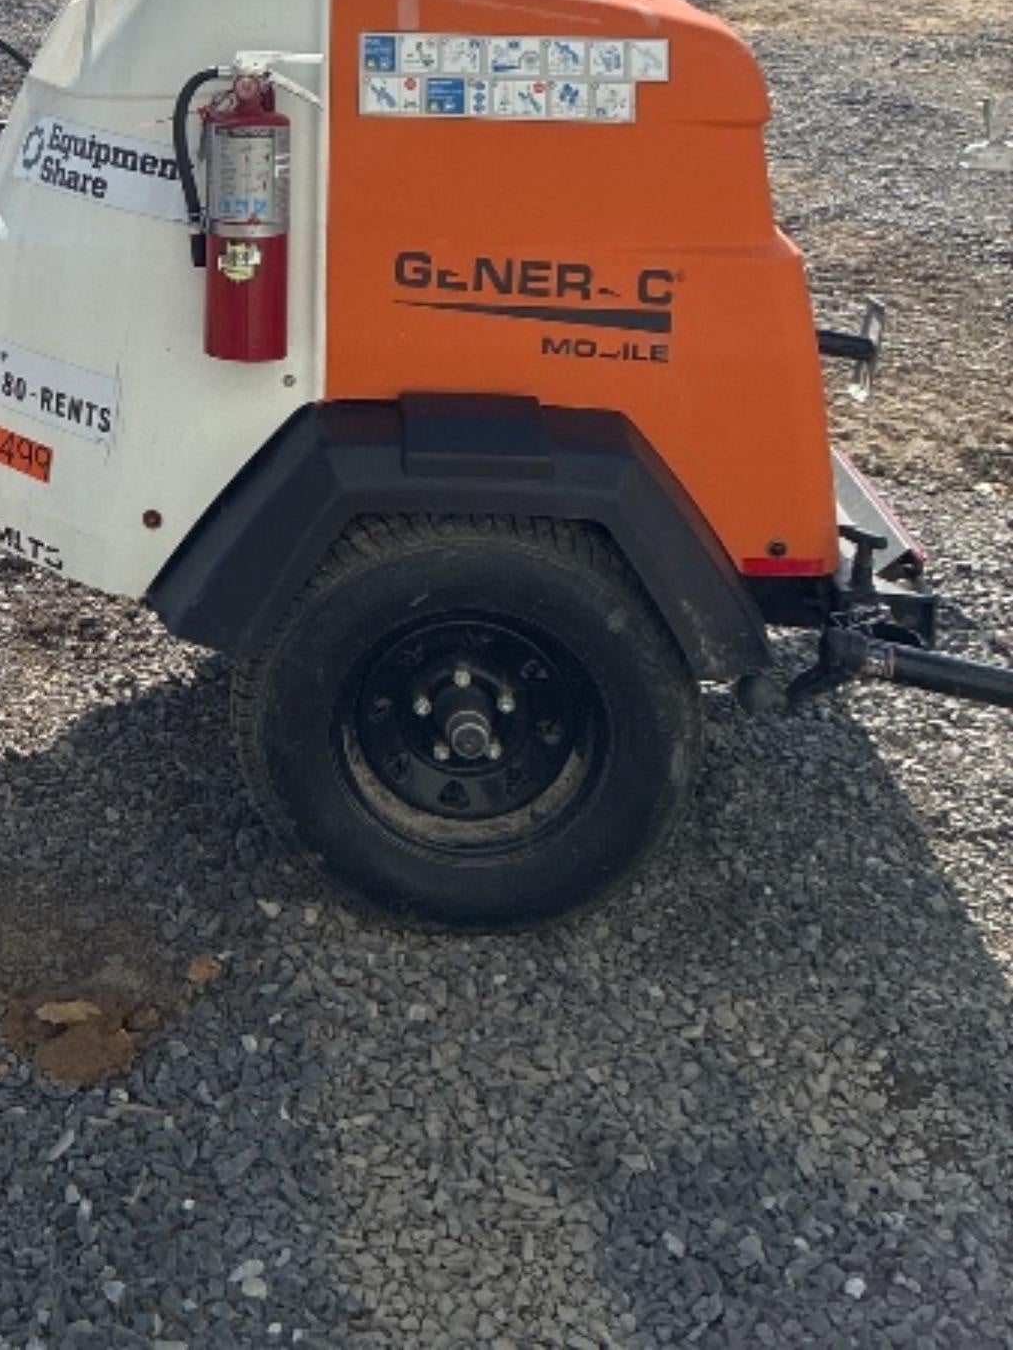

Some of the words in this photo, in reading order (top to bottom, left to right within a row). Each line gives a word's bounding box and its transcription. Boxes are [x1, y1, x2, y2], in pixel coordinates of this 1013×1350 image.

[47, 123, 194, 181] Equipmen
[40, 156, 107, 198] Share
[394, 251, 673, 306] GENERC
[541, 337, 668, 363] MOILE
